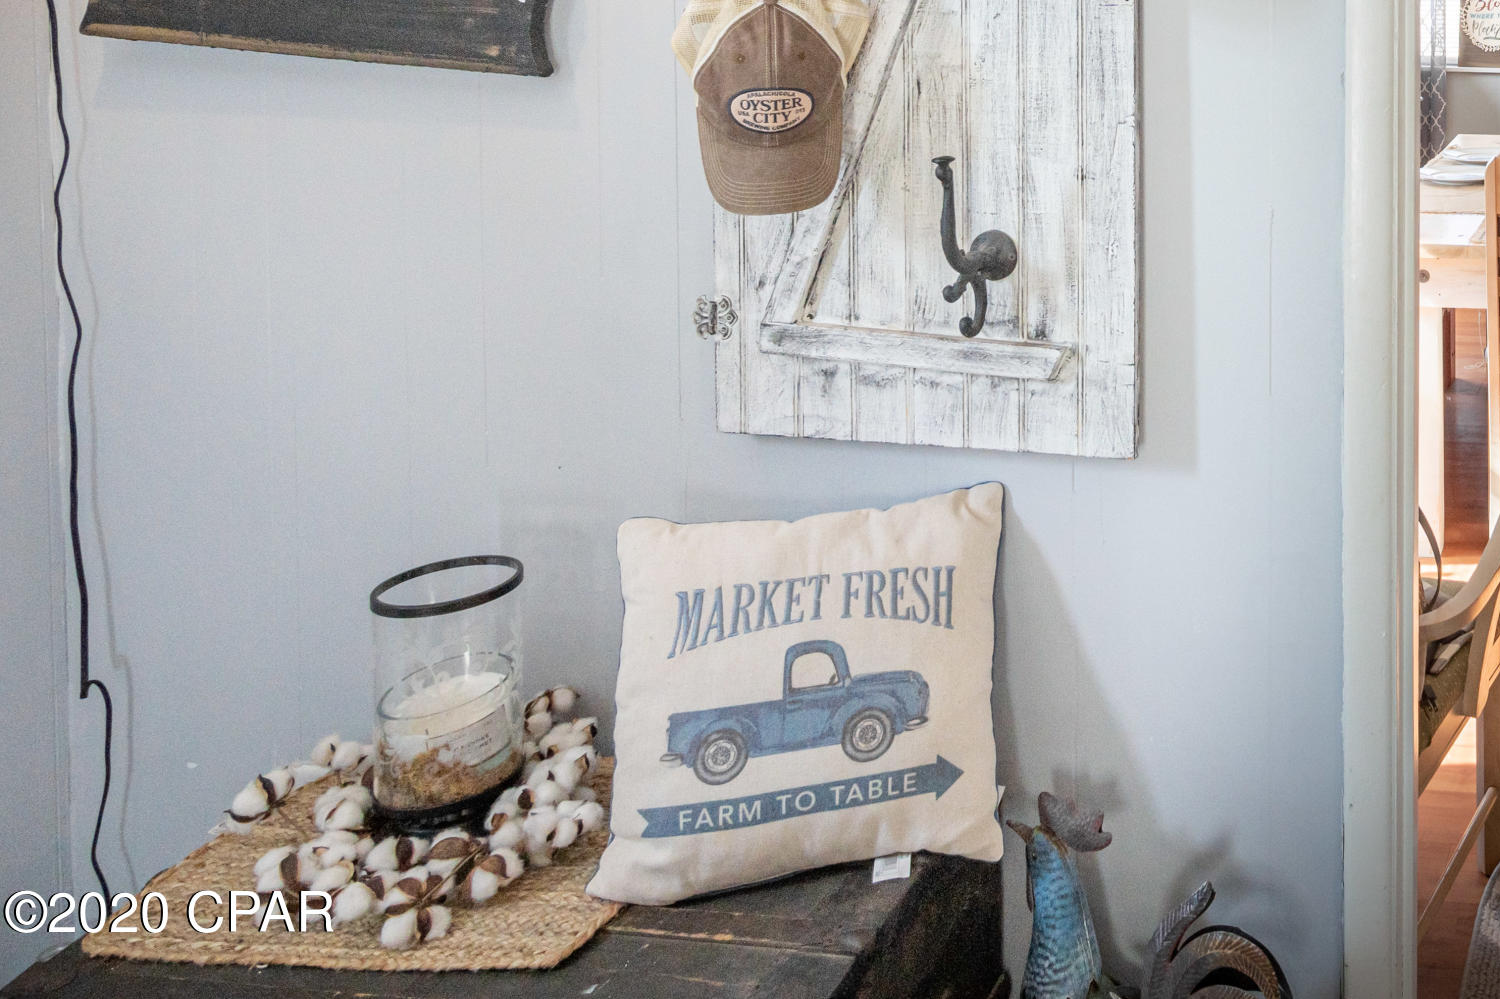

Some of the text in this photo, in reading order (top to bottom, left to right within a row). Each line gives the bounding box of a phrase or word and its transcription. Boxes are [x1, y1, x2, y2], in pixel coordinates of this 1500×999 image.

[1470, 12, 1494, 20] WHERE
[740, 97, 803, 112] OYSTER
[753, 110, 792, 124] CITY
[667, 564, 957, 659] MARKET FRESH
[678, 772, 919, 831] FARM TO TABLE
